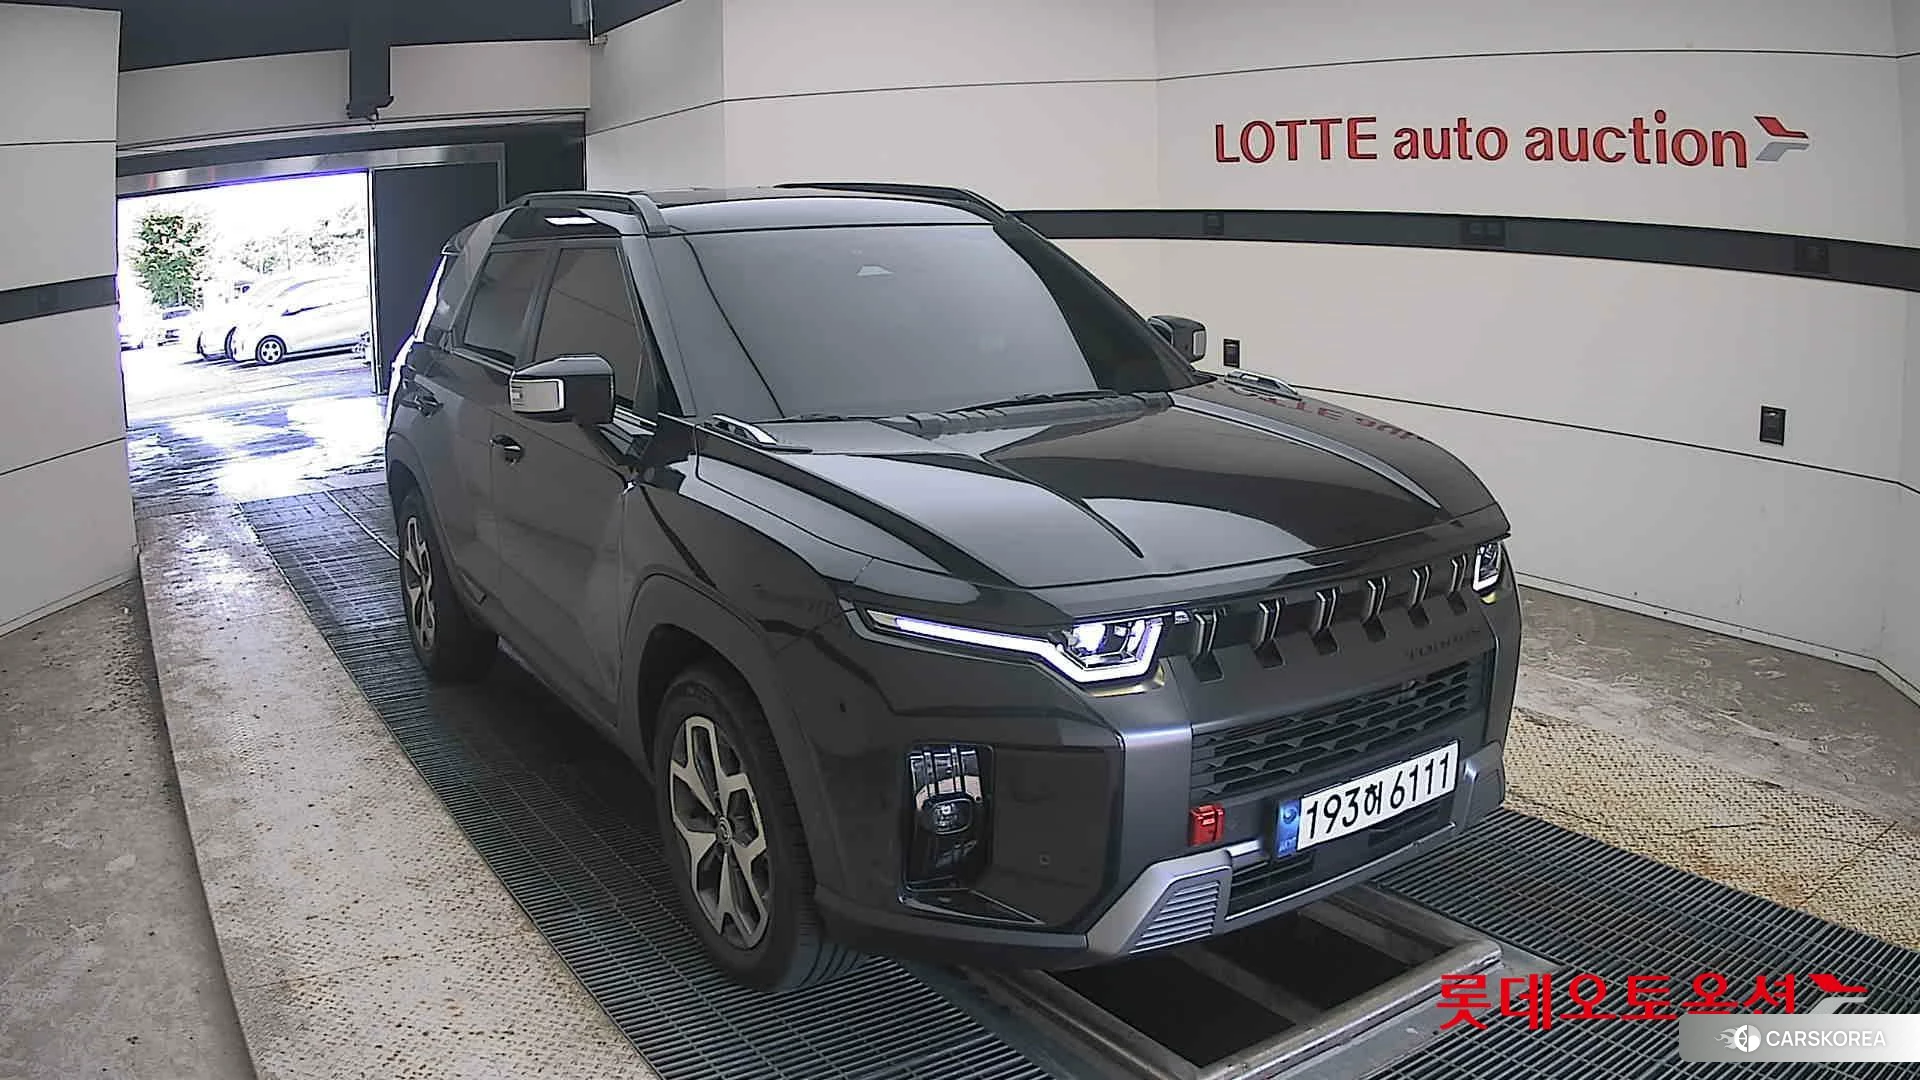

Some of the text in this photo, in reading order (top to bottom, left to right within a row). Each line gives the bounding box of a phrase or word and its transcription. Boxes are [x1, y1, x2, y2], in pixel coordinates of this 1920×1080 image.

[1214, 109, 1748, 169] LOTTE auto auction
[1306, 751, 1450, 840] 193허 6111
